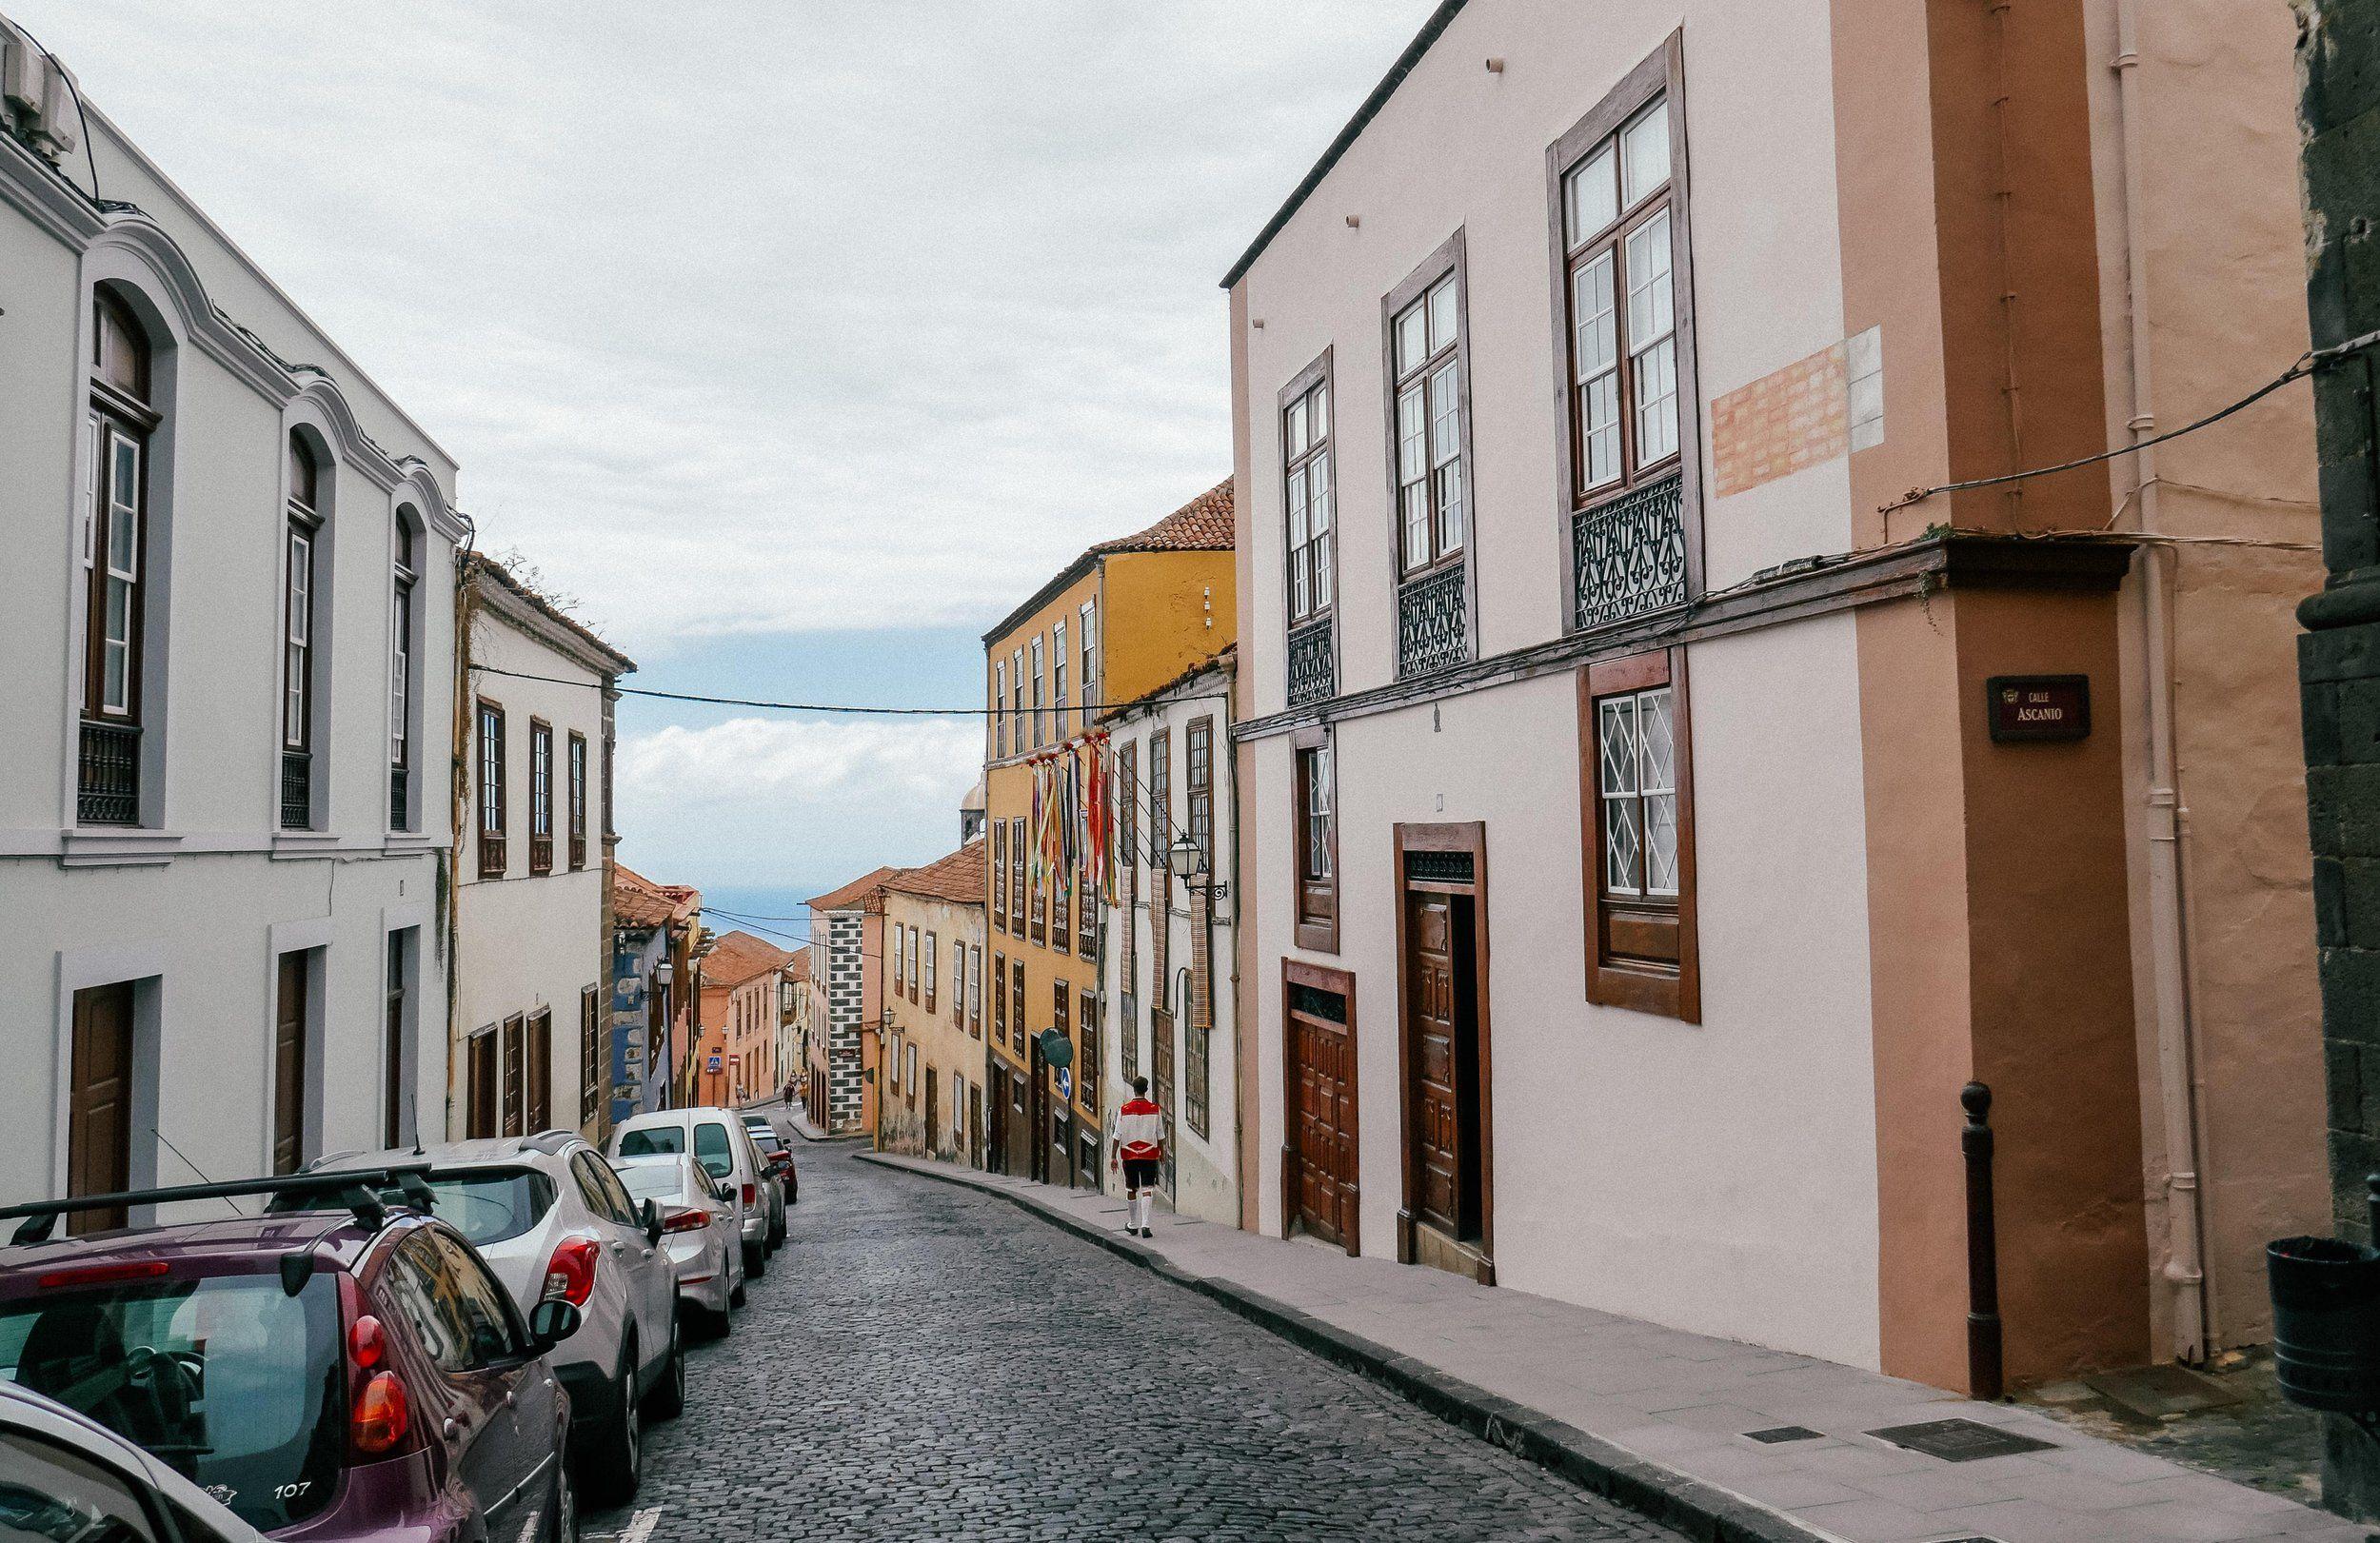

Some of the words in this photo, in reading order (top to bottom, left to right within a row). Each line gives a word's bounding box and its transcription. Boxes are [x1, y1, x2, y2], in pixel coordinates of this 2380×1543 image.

[2029, 692, 2049, 702] CALLE
[2017, 707, 2062, 722] ASCANIO
[274, 1481, 311, 1499] 107
